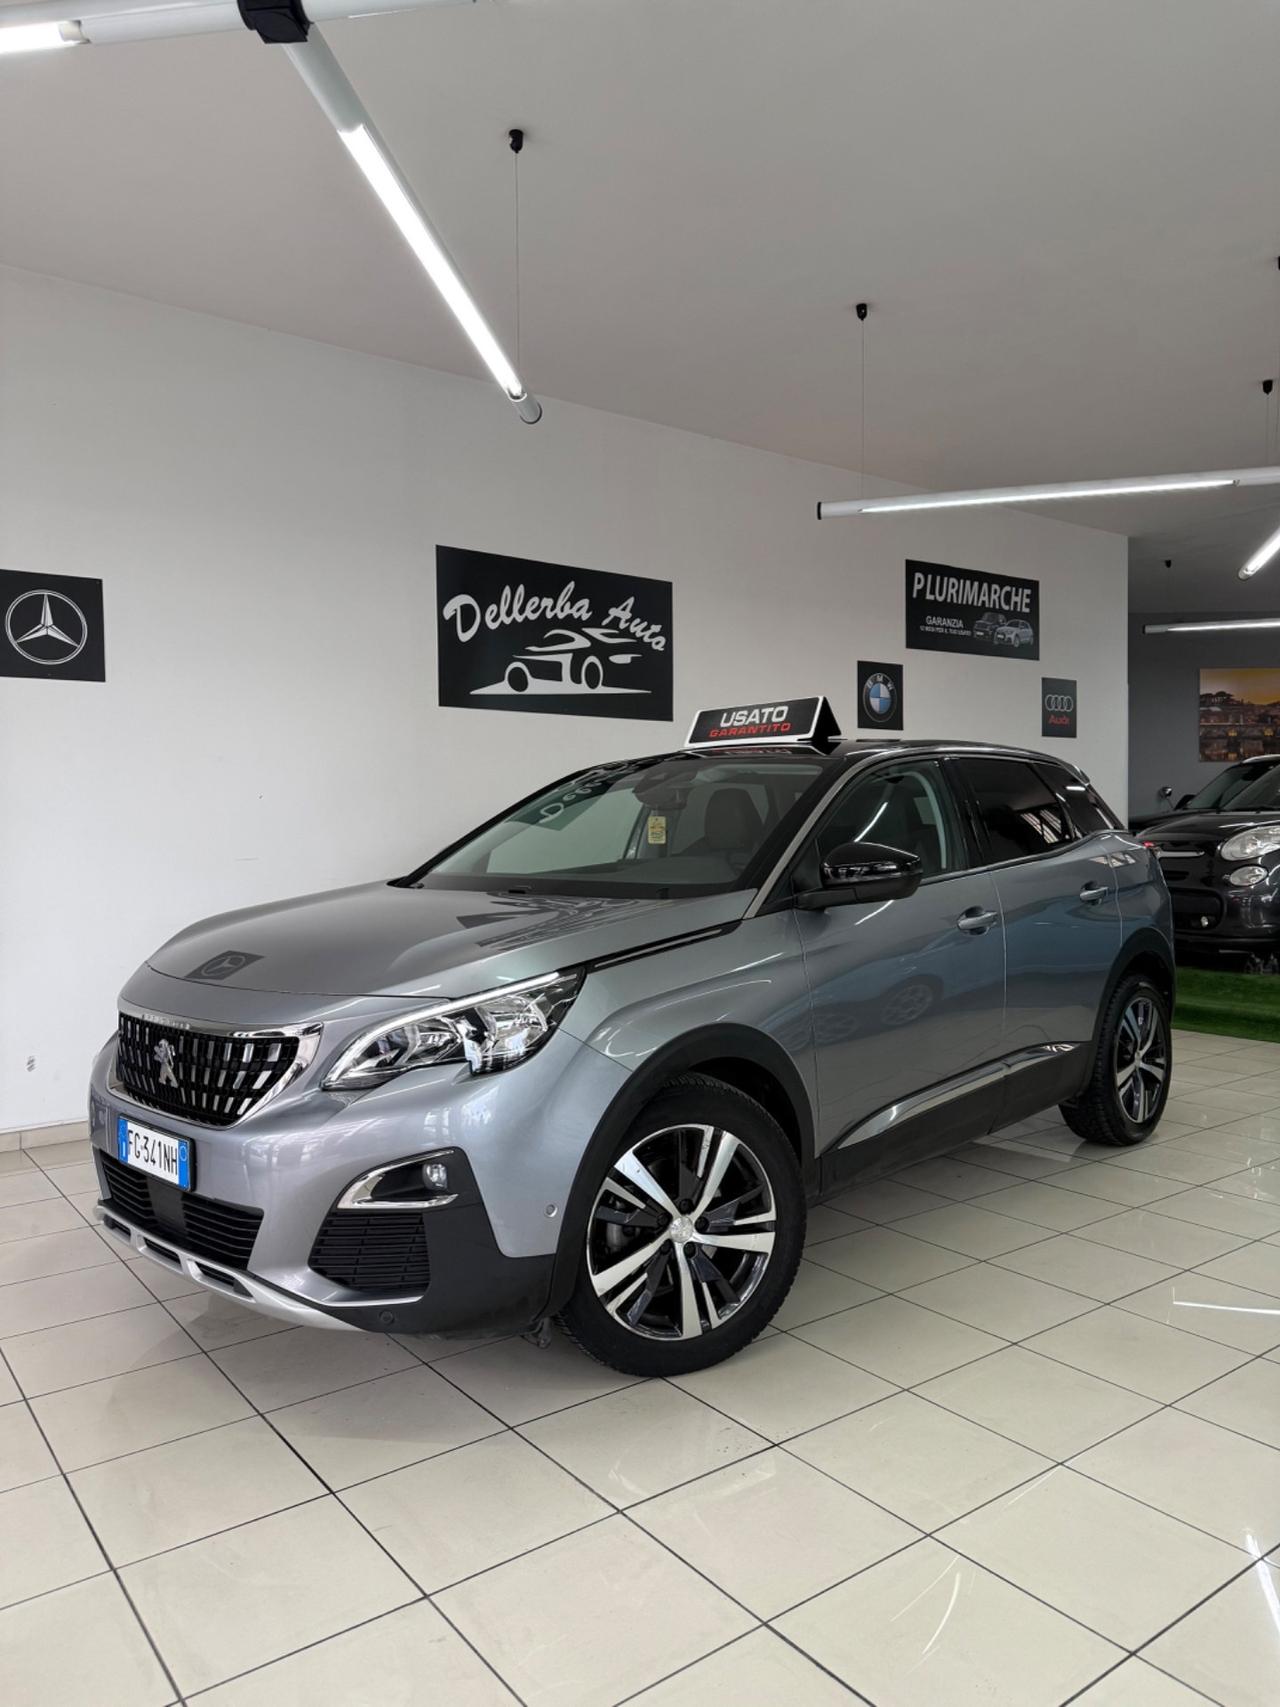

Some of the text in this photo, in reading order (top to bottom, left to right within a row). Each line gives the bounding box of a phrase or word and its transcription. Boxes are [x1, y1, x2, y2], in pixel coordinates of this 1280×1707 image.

[912, 572, 1032, 613] PLURIMARCHE
[442, 580, 667, 651] Dellerba Auto
[925, 615, 964, 628] GARANZIA
[720, 706, 789, 728] USATO
[1048, 714, 1070, 725] Audi
[709, 722, 791, 738] GARANTITO
